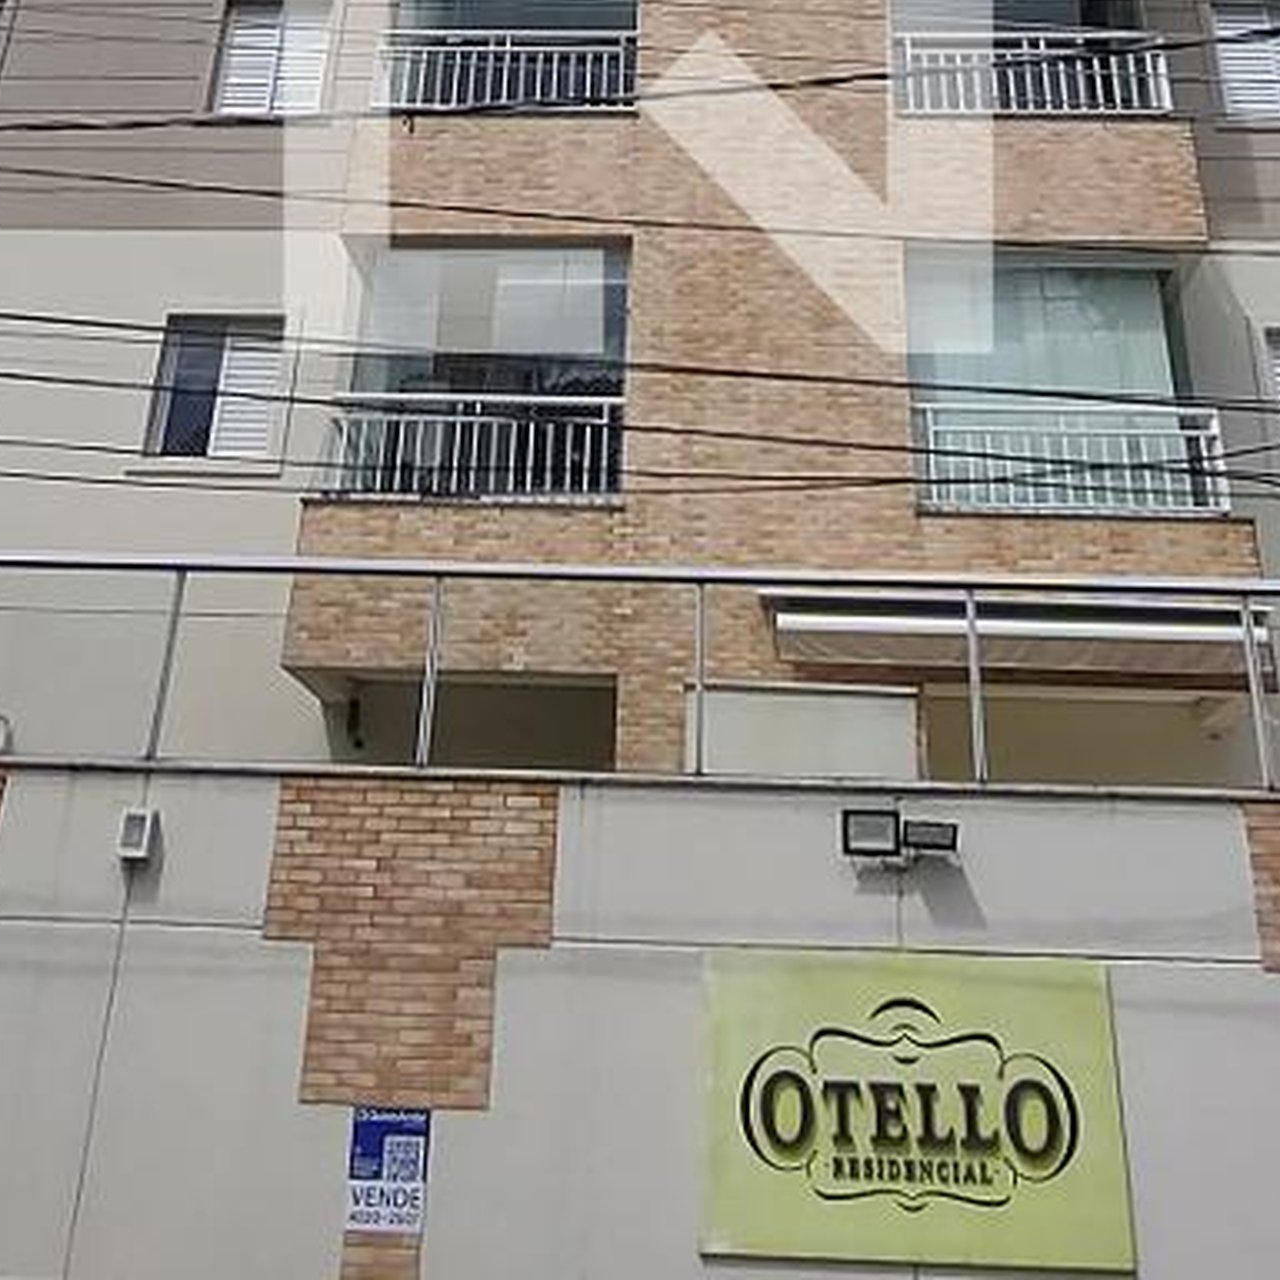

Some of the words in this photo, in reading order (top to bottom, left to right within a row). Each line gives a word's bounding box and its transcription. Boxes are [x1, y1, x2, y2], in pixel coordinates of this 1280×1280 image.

[758, 1069, 1063, 1164] OTELLO
[830, 1156, 994, 1186] RESIDENCIAL
[351, 1185, 421, 1209] VENDE
